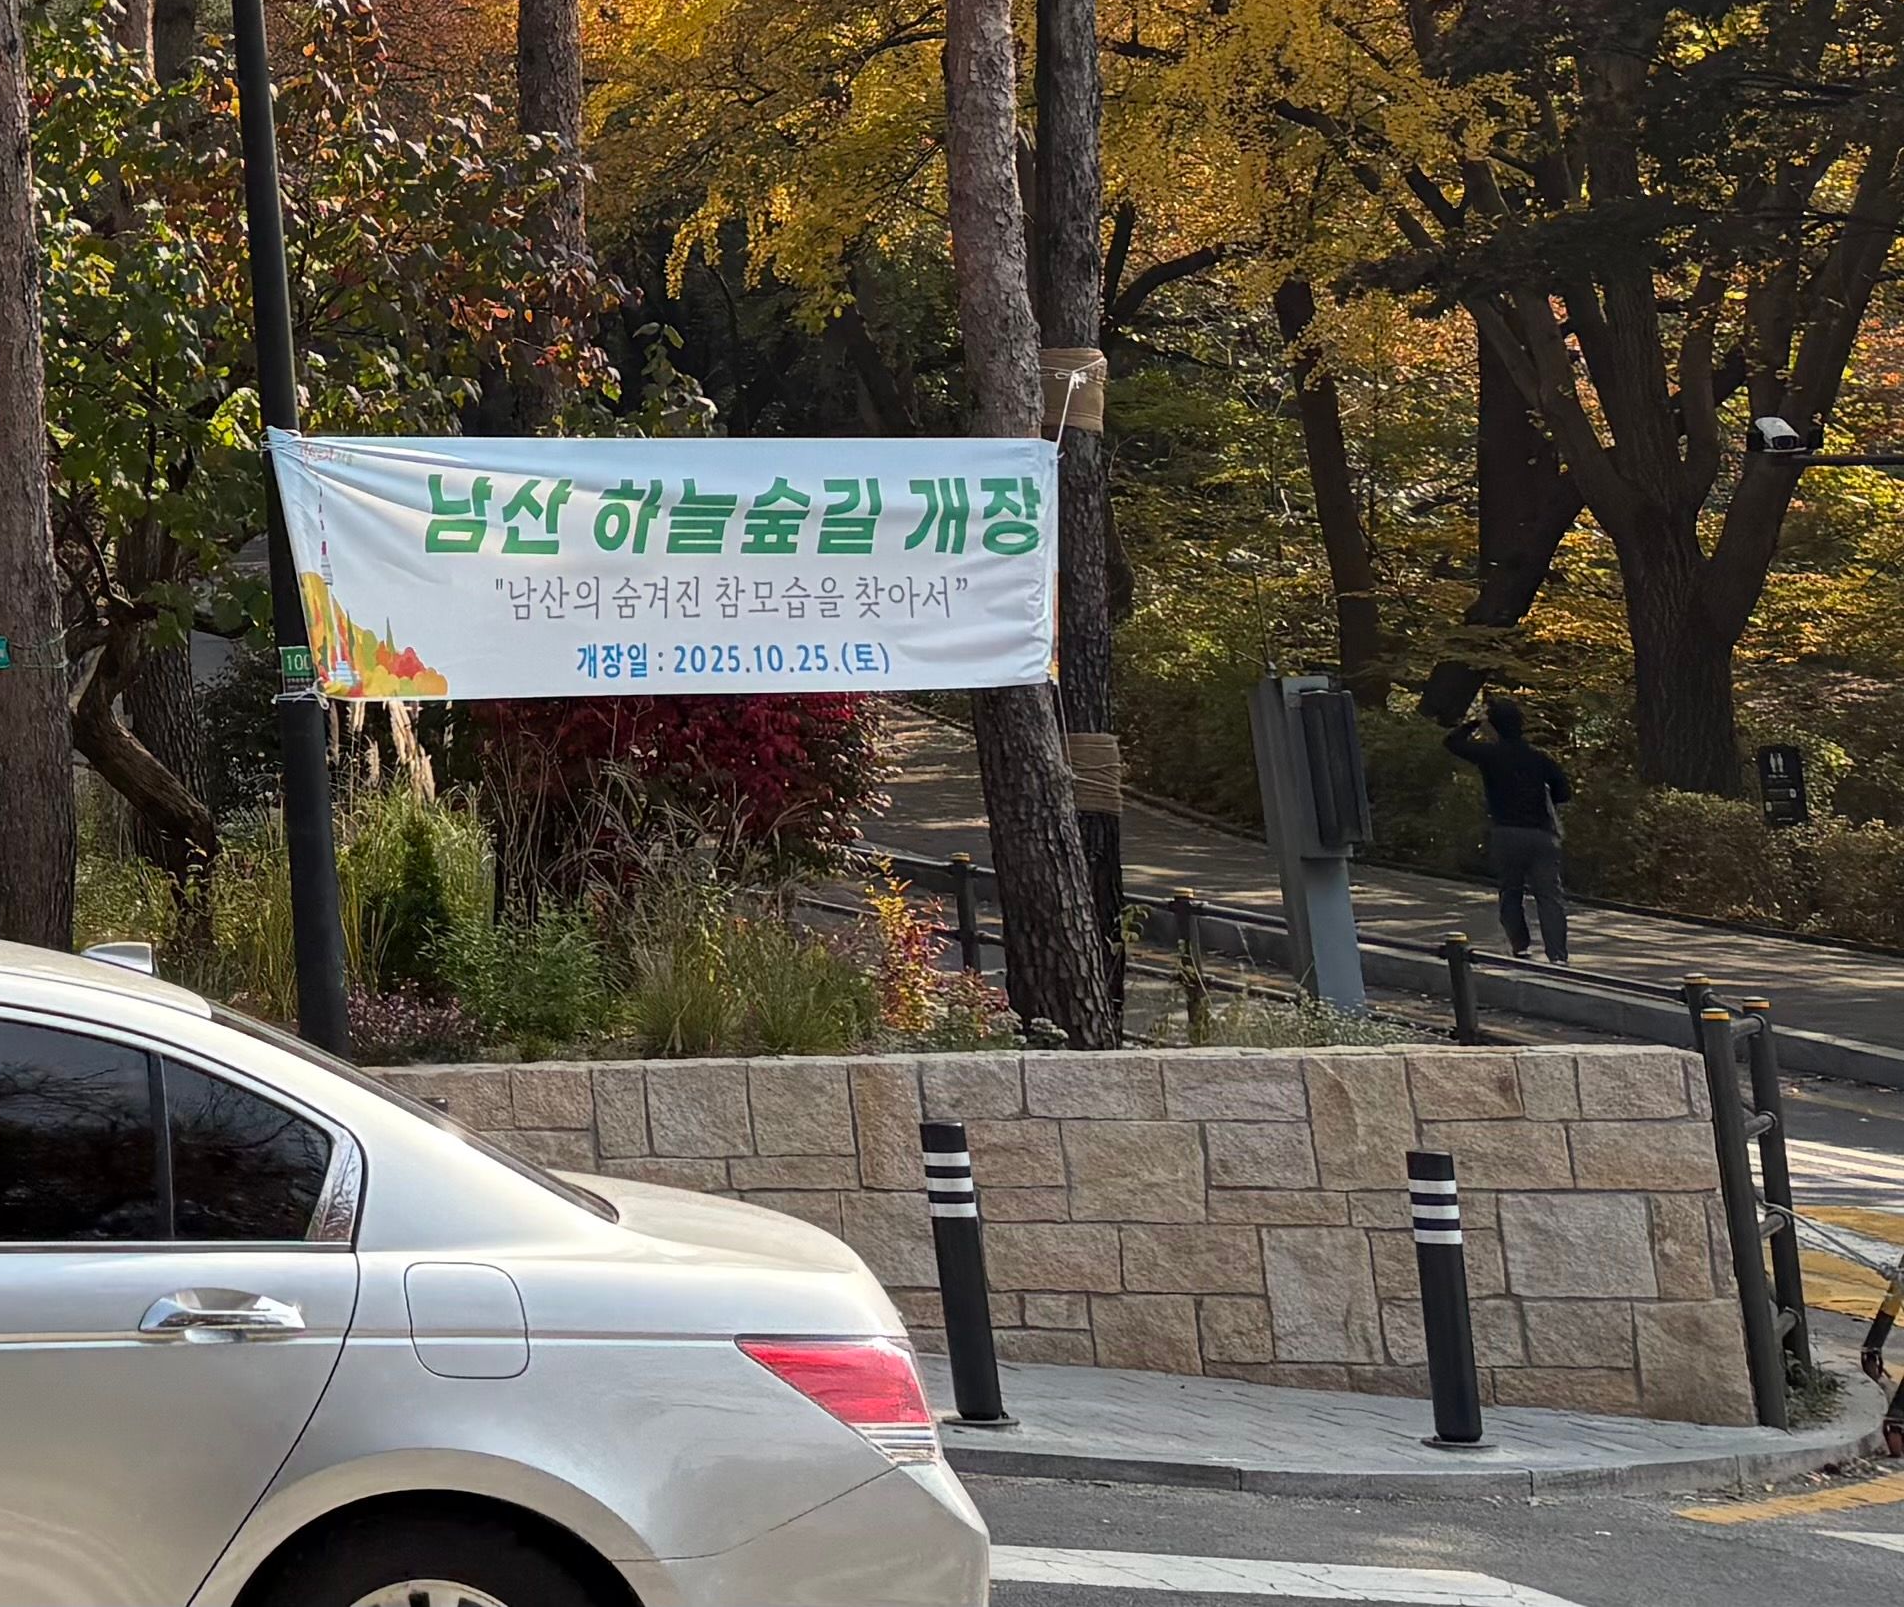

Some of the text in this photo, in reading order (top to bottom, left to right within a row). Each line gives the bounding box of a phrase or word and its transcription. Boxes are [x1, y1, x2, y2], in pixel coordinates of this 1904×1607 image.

[425, 473, 1041, 555] 남산 하늘숲길 개장
[612, 576, 700, 619] 숨겨진
[715, 576, 845, 619] 참모습을
